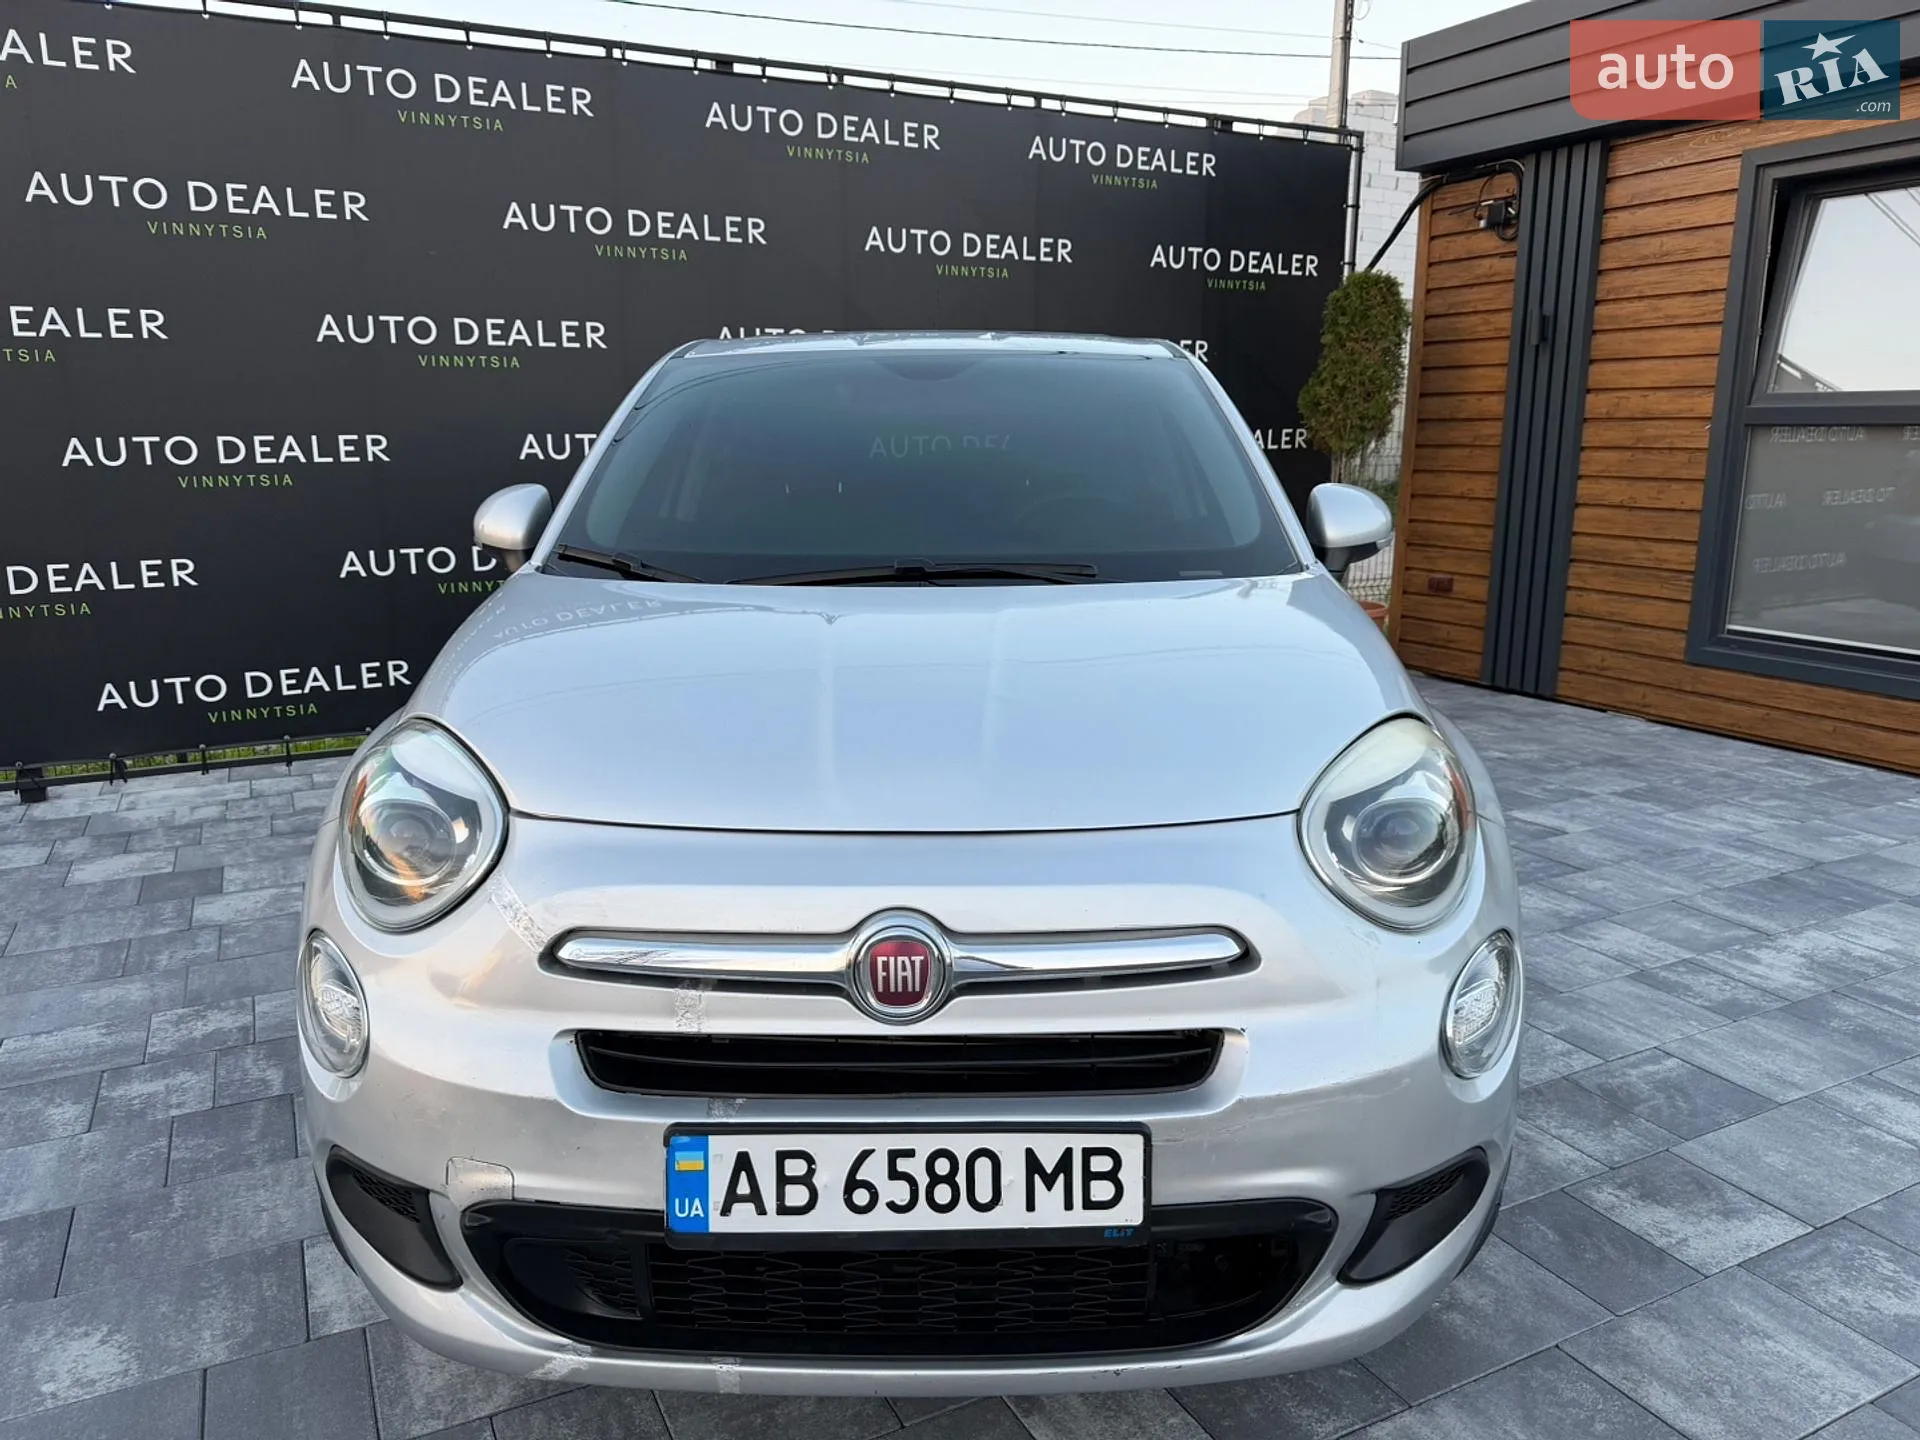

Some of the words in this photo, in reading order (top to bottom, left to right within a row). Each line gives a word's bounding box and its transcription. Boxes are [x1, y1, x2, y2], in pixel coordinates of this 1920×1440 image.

[0, 29, 136, 74] ALER
[291, 59, 417, 98] AUTO
[434, 73, 594, 117] DEALER
[397, 109, 504, 132] VINNYTSIA
[706, 102, 803, 136] AUTO
[816, 113, 941, 151] DEALER
[786, 144, 870, 164] VINNYTSIA
[1029, 136, 1106, 165] AUTO
[1116, 144, 1216, 177] DEALER
[26, 171, 168, 209] AUTO
[188, 181, 369, 221] DEALER
[1092, 174, 1158, 189] VINNYTSIA
[147, 220, 267, 240] VINNYTSIA
[503, 202, 612, 235] AUTO
[628, 209, 767, 245] DEALER
[595, 244, 688, 261] VINNYTSIA
[865, 226, 951, 256] AUTO
[962, 232, 1073, 264] DEALER
[1150, 245, 1220, 271] AUTO
[1230, 250, 1319, 277] DEALER
[936, 264, 1009, 279] VINNYTSIA
[1207, 278, 1266, 291] VINNYTSIA
[9, 305, 169, 340] EALER
[317, 314, 437, 345] AUTO
[453, 318, 608, 349] DEALER
[418, 354, 520, 369] VINNYTSIA
[62, 436, 198, 467] AUTO
[217, 434, 391, 464] DEALER
[519, 433, 598, 460] AUT
[1254, 428, 1308, 449] ALER
[178, 473, 293, 488] VINNYTSIA
[6, 558, 198, 595] DEALER
[340, 546, 456, 578] AUTO
[97, 674, 227, 712] AUTO
[244, 660, 412, 698] DEALER
[208, 702, 319, 723] VINNYTSIA
[877, 955, 924, 993] FIAT
[719, 1149, 819, 1217] AB
[843, 1147, 1003, 1215] 6580
[1025, 1146, 1124, 1213] MB
[675, 1199, 704, 1218] UA
